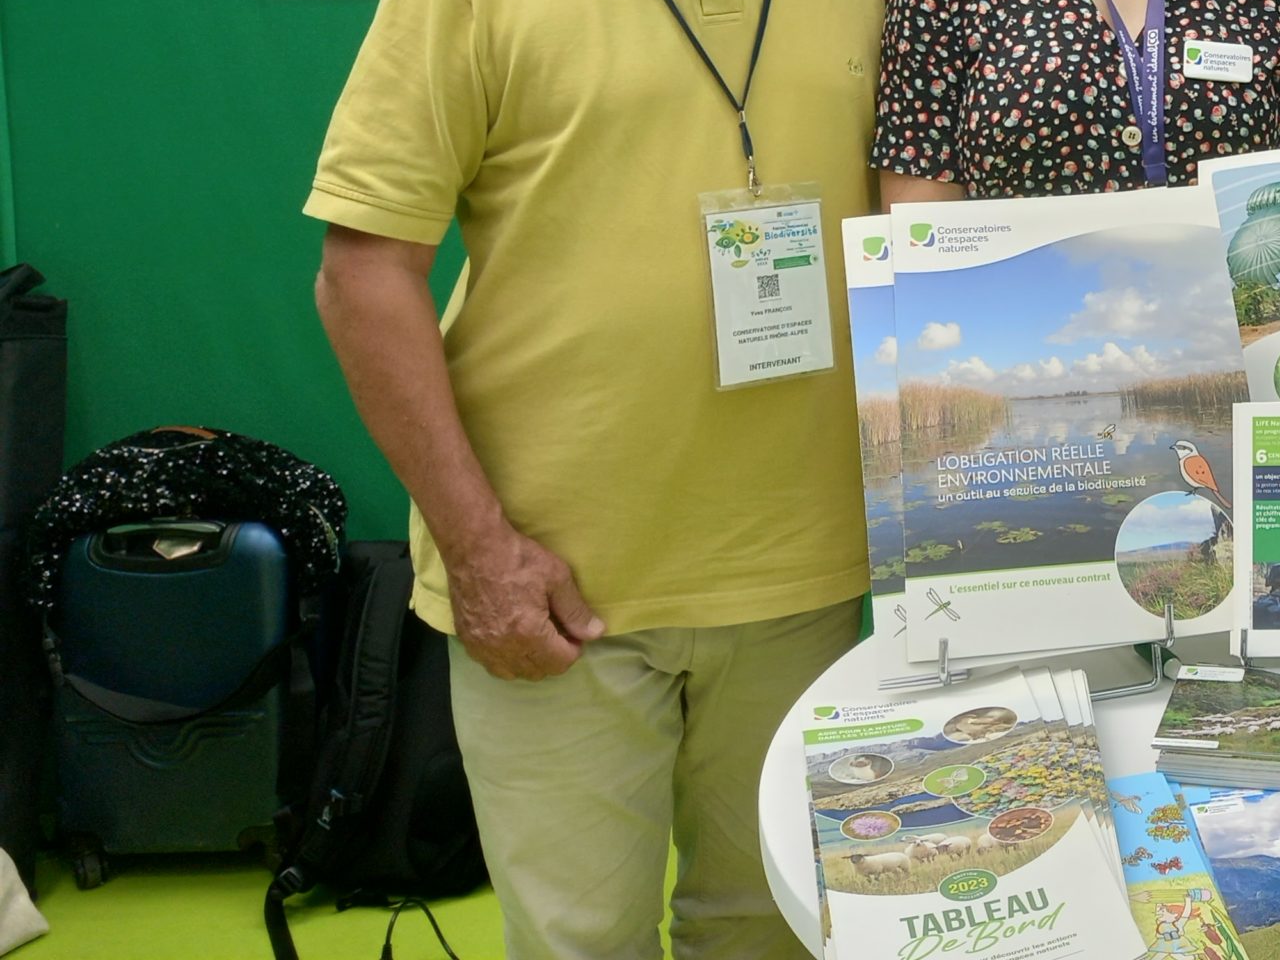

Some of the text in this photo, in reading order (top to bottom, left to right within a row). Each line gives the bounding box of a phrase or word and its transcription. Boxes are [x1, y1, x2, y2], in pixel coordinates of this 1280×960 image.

[1203, 51, 1251, 62] Conservatoires
[1203, 58, 1236, 67] d'espaces
[1151, 128, 1159, 143] un
[764, 225, 818, 241] Biodiversité
[937, 224, 1012, 235] Conservatoires
[938, 235, 989, 245] d'espaces
[938, 243, 979, 253] naturels
[764, 305, 793, 314] FRANÇOIS
[732, 319, 813, 337] CONSERVATOIRE D'ESPACES
[738, 334, 769, 345] NATURELS
[749, 356, 802, 371] INTERVENANT
[937, 443, 1105, 471] L'OBLIGATION RÉELLE
[1255, 449, 1268, 464] 6
[938, 461, 1112, 489] ENVIRONNEMENTALE
[938, 475, 1146, 503] un outil au service de la biodiversité
[949, 581, 1000, 594] L'essentiel
[1002, 581, 1017, 590] sur
[1032, 577, 1074, 588] nouveau
[1076, 573, 1111, 584] contrat
[842, 700, 918, 712] Conservatoires
[843, 708, 895, 718] d'espaces
[843, 715, 886, 723] naturels
[875, 723, 908, 731] NATURE
[948, 877, 989, 895] 2023
[899, 887, 1050, 939] TABLEAU
[897, 902, 1066, 960] De Bord
[991, 946, 1030, 960] découvrir
[1046, 933, 1078, 946] actions
[1036, 941, 1071, 955] naturels
